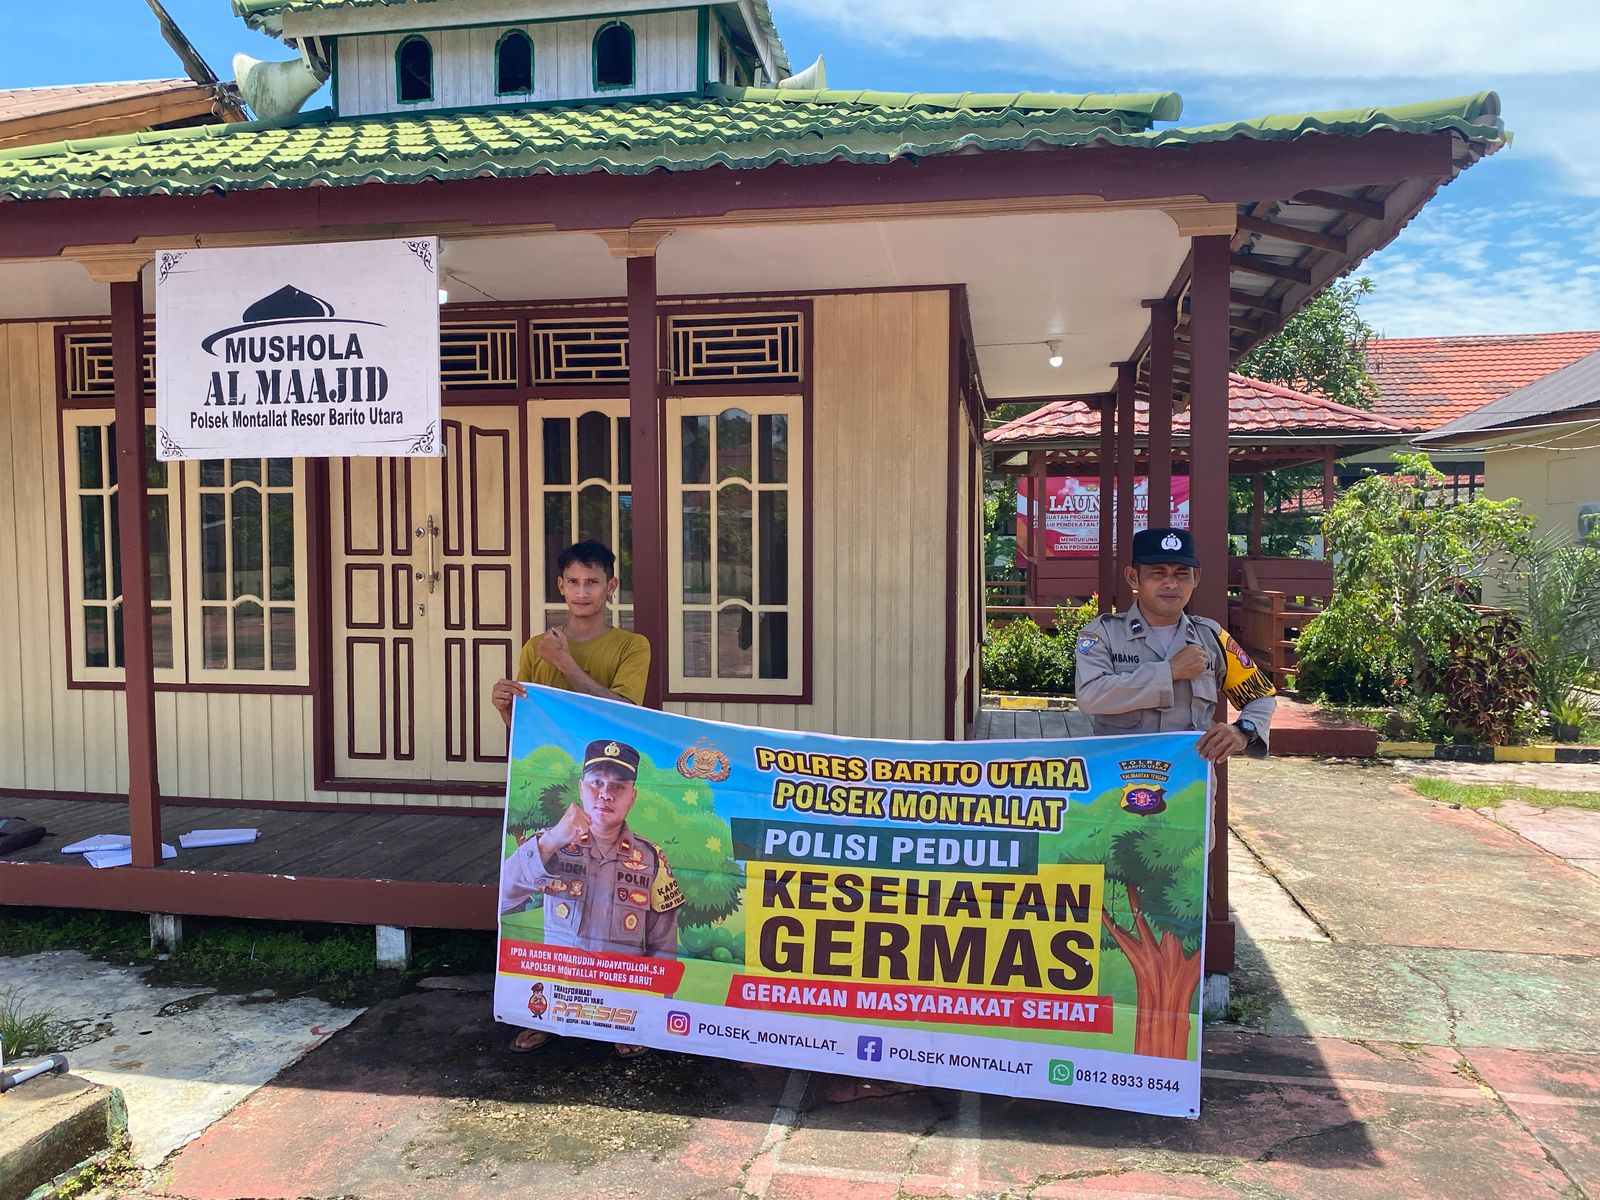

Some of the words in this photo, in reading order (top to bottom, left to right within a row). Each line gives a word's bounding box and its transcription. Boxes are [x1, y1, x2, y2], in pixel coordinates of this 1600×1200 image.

[225, 333, 363, 363] MUSHOLA
[204, 370, 246, 406] AL
[255, 366, 389, 406] MAAJID
[190, 411, 229, 429] Polsek
[232, 408, 287, 428] Montallat
[291, 409, 325, 427] Resor
[329, 408, 365, 426] Barito
[369, 407, 403, 425] Utara
[757, 748, 866, 781] POLRES
[873, 759, 981, 785] BARITO
[987, 759, 1088, 791] UTARA
[1121, 760, 1169, 768] POLRES
[774, 780, 886, 817] POLSEK
[890, 790, 1066, 831] MONTALLAT
[764, 828, 878, 862] POLISI
[891, 836, 1020, 868] PEDULI
[560, 861, 587, 876] ADEN
[617, 871, 650, 888] POLRI
[761, 869, 1091, 924] KESEHATAN
[510, 947, 527, 957] IPDA
[528, 950, 552, 960] RADEN
[553, 952, 595, 967] KOMARUDIN
[759, 915, 1094, 990] GERMAS
[521, 961, 556, 973] KAPOLSEK
[557, 966, 597, 979] MONTALLAT
[599, 971, 627, 983] POLRES
[628, 975, 653, 986] BARUT
[551, 1000, 638, 1025] PRESISI
[742, 982, 848, 1009] GERAKAN
[856, 990, 1015, 1018] MASYARAKAT
[1021, 1000, 1099, 1023] SEHAT
[698, 1022, 845, 1056] POLSEK_MONTALLAT_
[889, 1047, 945, 1065] POLSEK
[949, 1054, 1033, 1075] MONTALLAT
[1076, 1068, 1107, 1084] 0812
[1111, 1072, 1144, 1088] 8933
[1148, 1077, 1180, 1093] 8544
